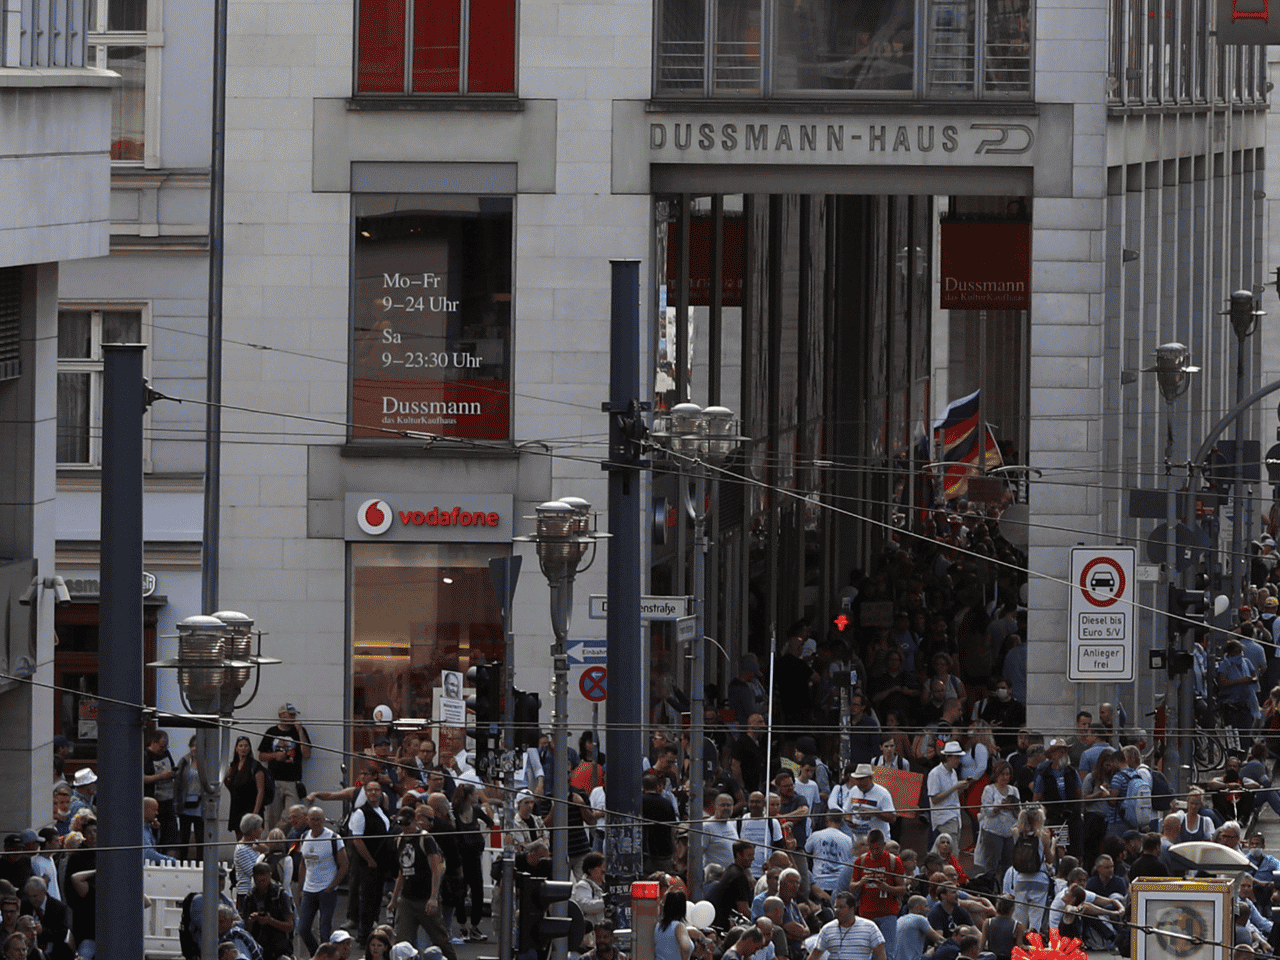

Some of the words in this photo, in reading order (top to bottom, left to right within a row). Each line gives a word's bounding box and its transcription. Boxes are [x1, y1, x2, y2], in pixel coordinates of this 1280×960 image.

[650, 122, 959, 152] DUSSMANN-HAUS
[944, 277, 1025, 291] Dussmann
[429, 296, 460, 312] Uhr
[382, 329, 402, 345] Sa
[452, 352, 483, 369] Uhr
[382, 396, 482, 415] Dussmann
[382, 416, 395, 425] das
[398, 507, 500, 528] vodafone
[1081, 615, 1107, 625] Diesel
[1109, 615, 1122, 625] bis
[1082, 627, 1103, 638] Euro
[1105, 627, 1121, 638] 5/V
[1083, 648, 1120, 660] Anlieger
[1093, 659, 1109, 669] frei
